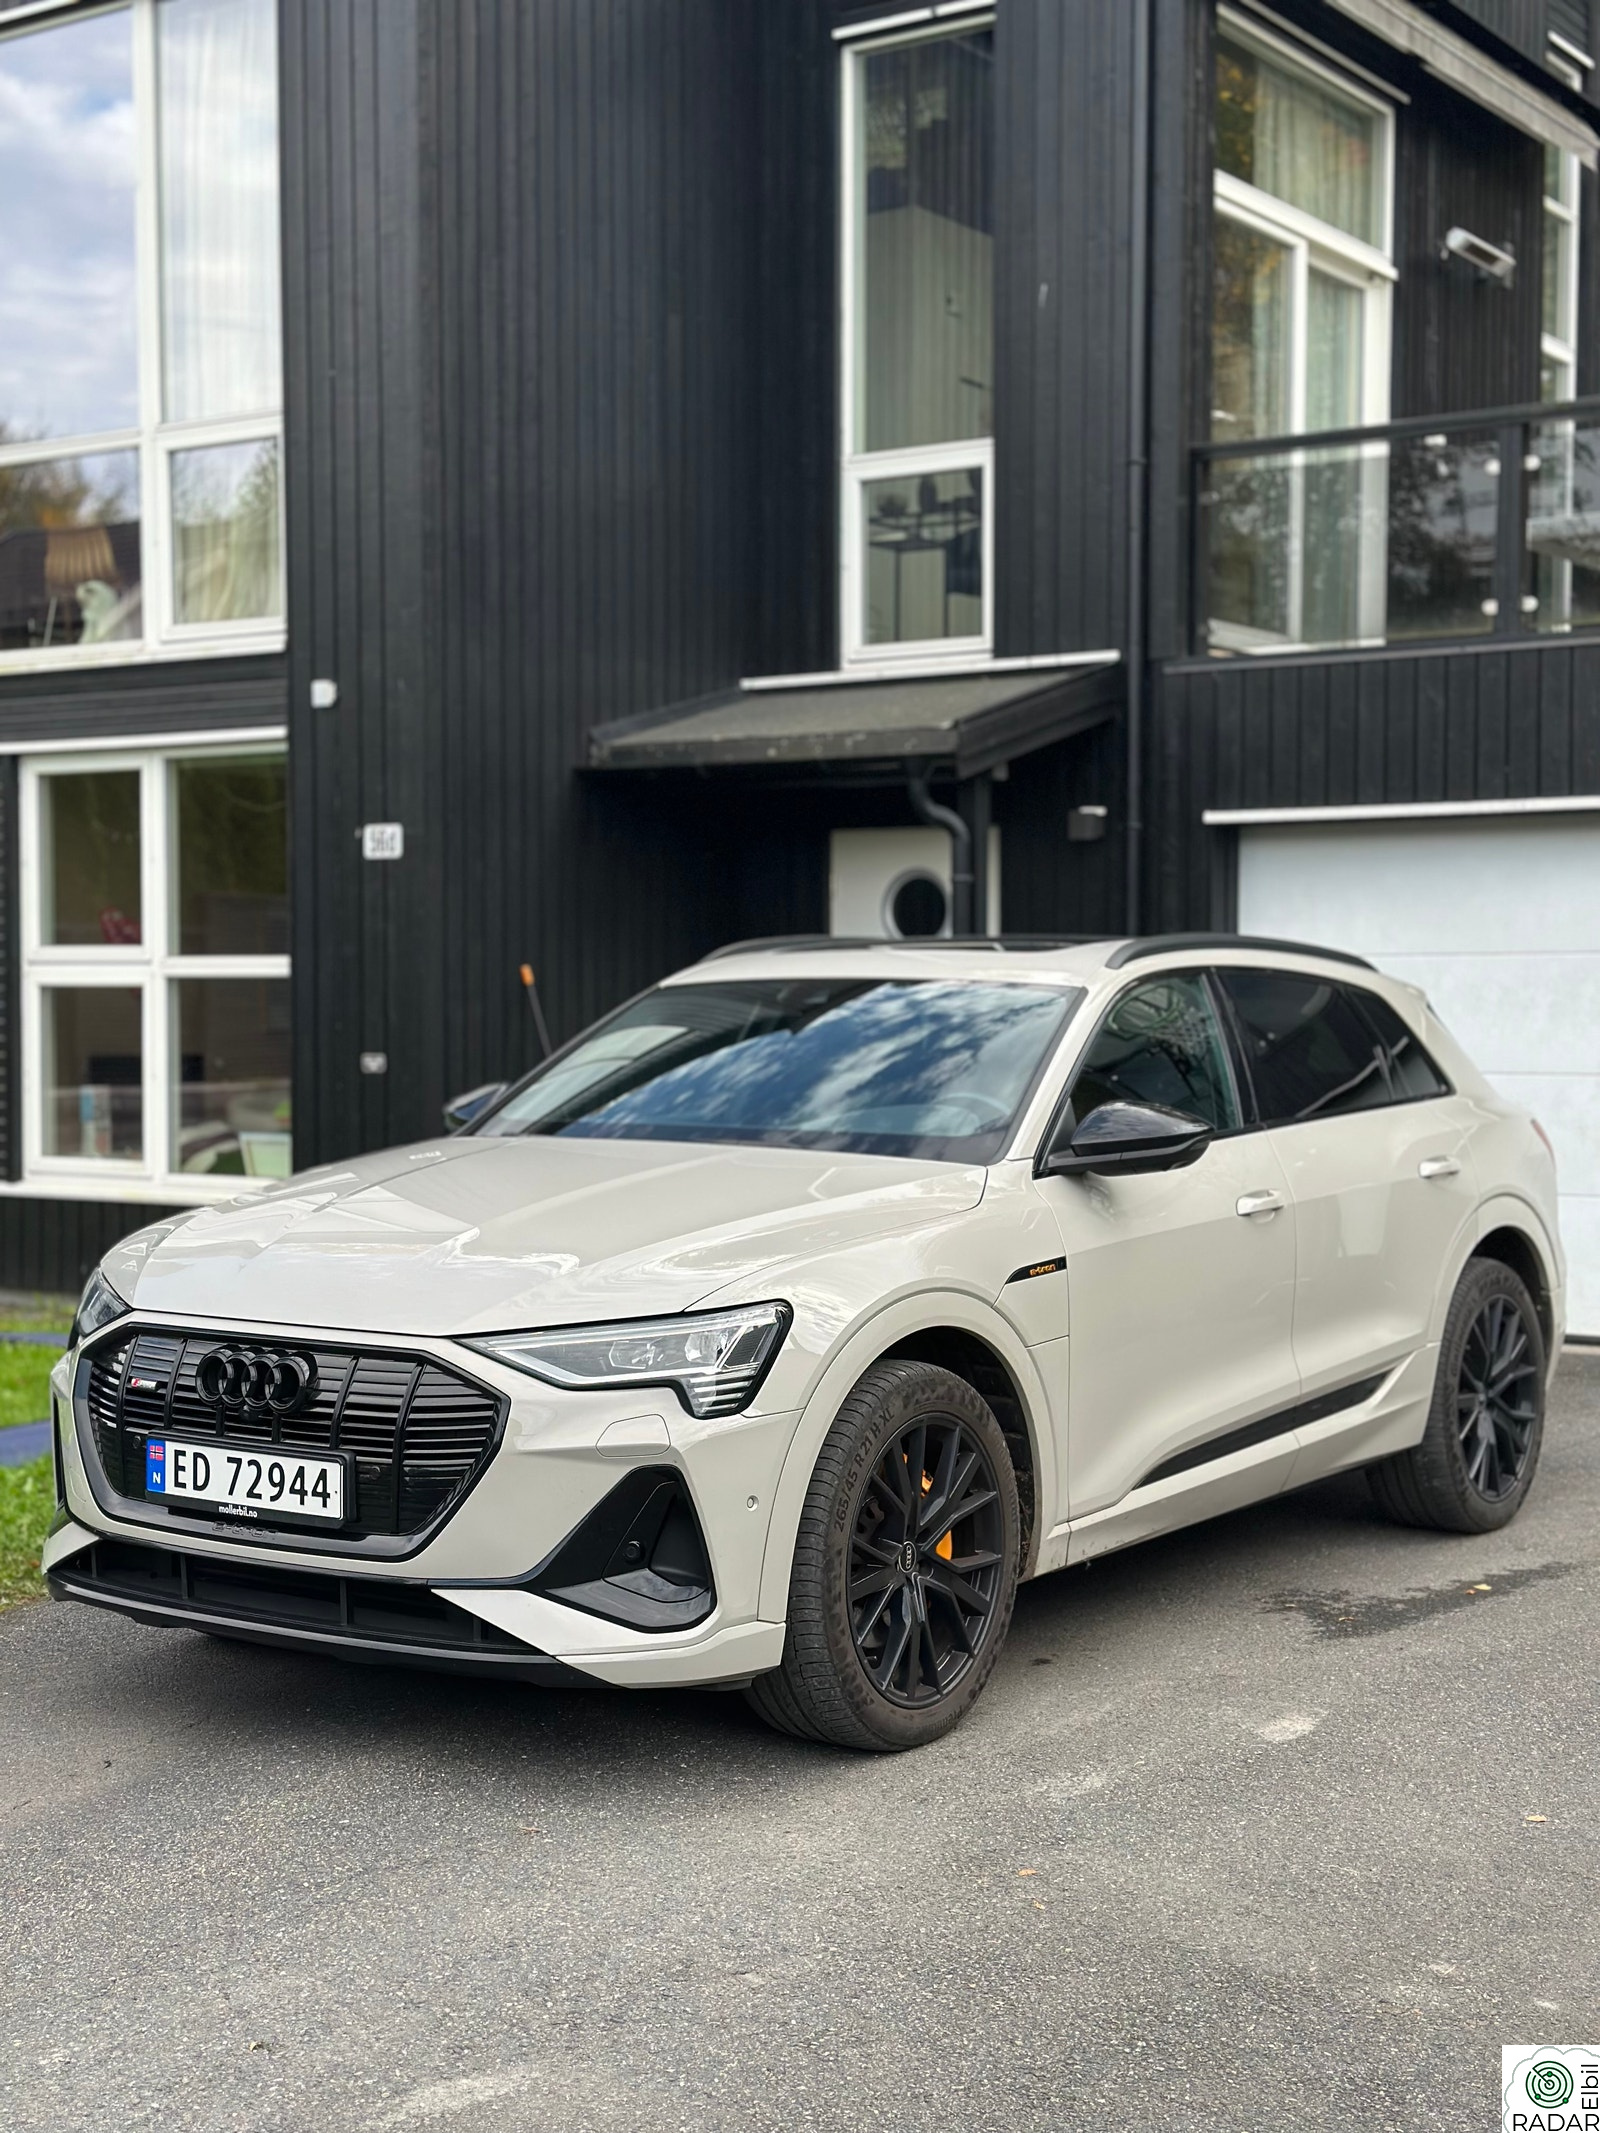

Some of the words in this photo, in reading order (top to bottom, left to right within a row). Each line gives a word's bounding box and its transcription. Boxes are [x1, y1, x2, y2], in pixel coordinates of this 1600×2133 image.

[152, 1471, 161, 1484] N
[173, 1449, 211, 1492] ED
[226, 1456, 331, 1509] 72944
[833, 1468, 858, 1533] 265/45
[853, 1453, 865, 1468] R
[859, 1438, 873, 1456] 21
